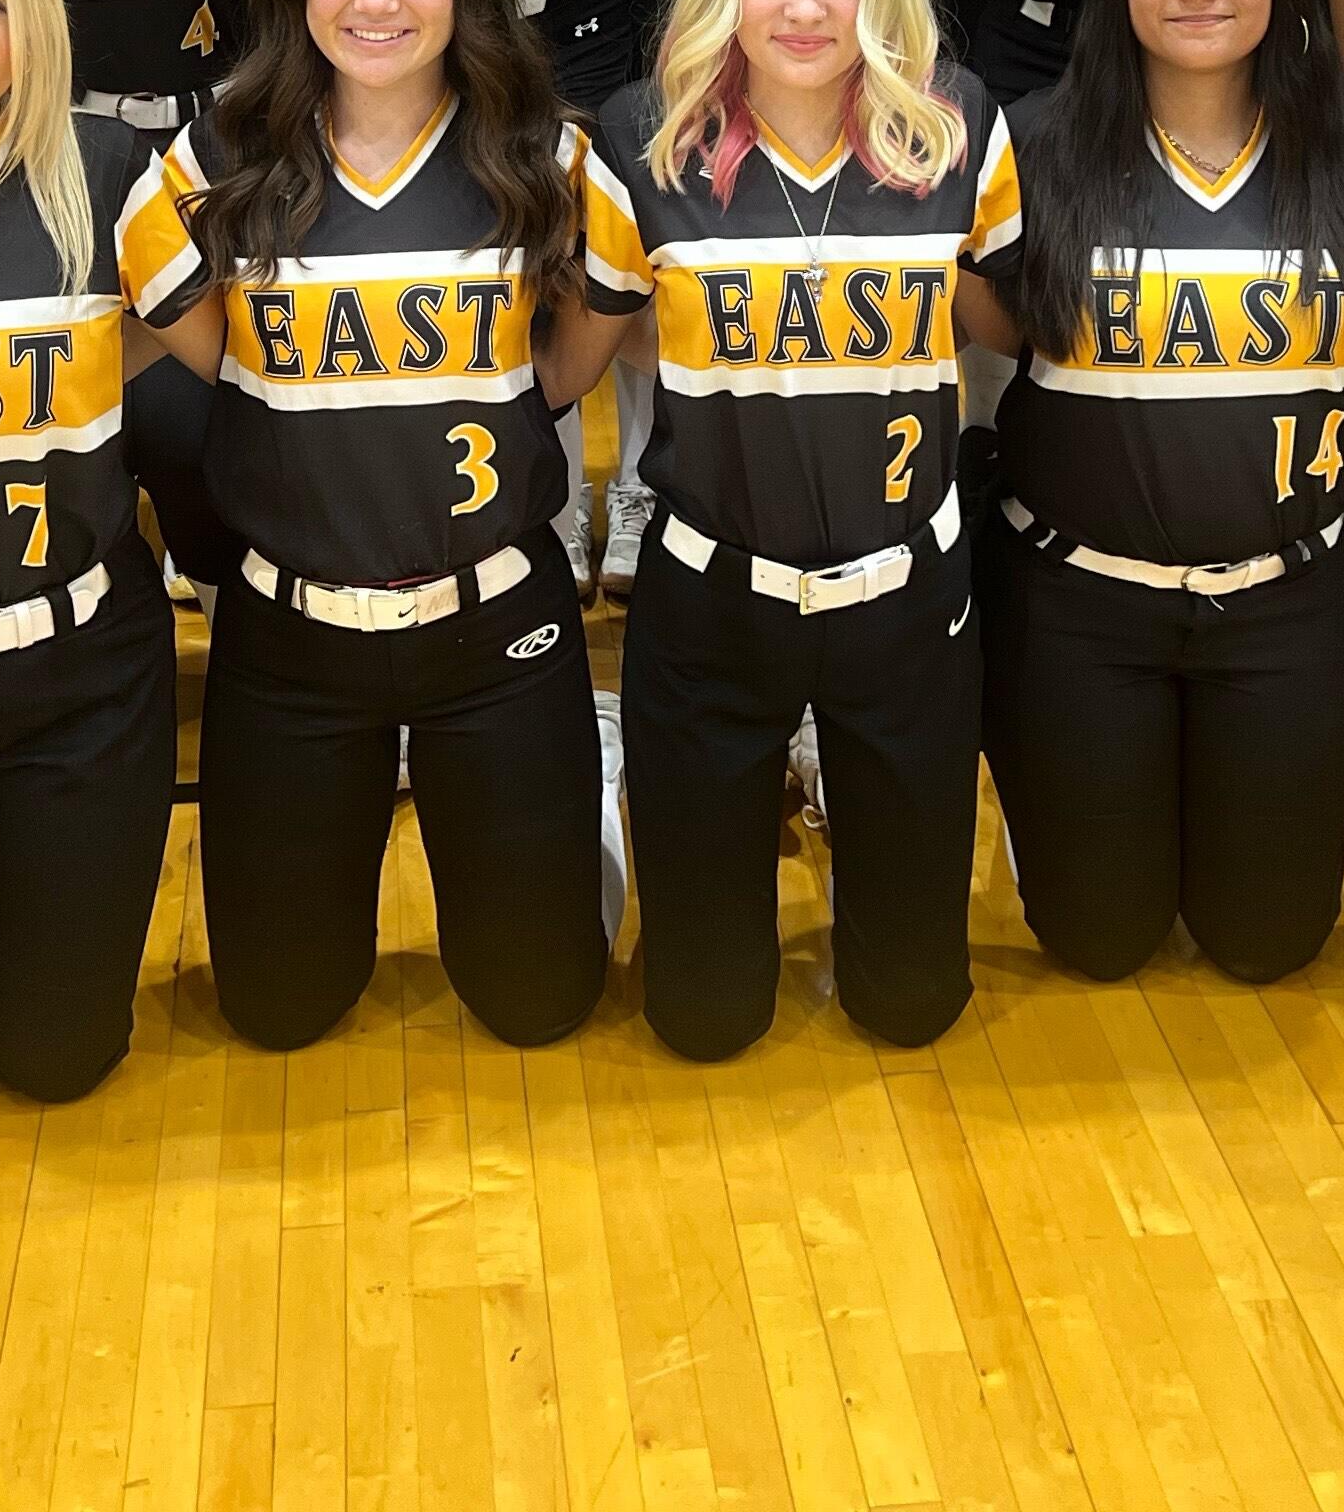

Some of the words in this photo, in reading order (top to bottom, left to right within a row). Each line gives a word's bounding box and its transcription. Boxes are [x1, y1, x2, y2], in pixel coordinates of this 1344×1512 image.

[244, 280, 513, 379] EAST
[694, 267, 947, 364] EAST
[445, 422, 499, 518] 3
[884, 414, 923, 504] 2
[4, 475, 50, 568] 7
